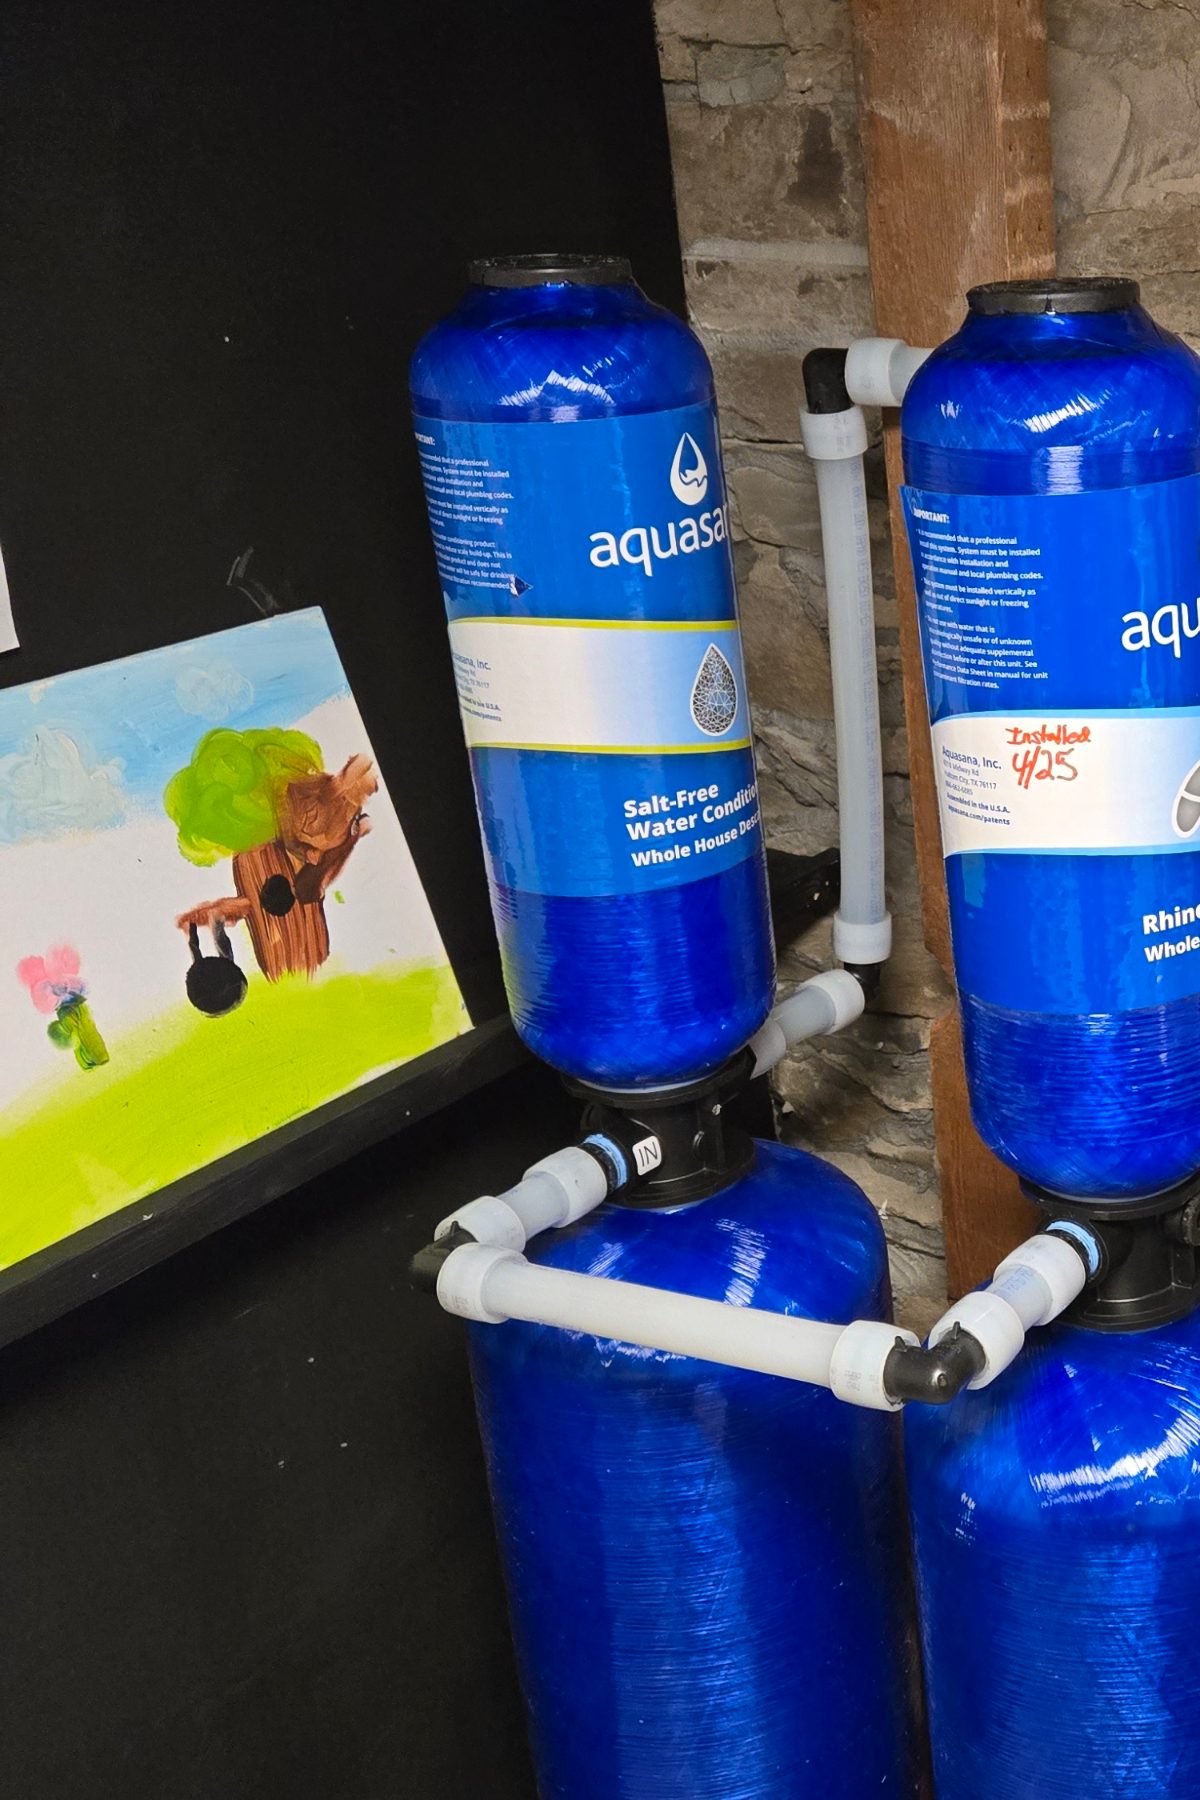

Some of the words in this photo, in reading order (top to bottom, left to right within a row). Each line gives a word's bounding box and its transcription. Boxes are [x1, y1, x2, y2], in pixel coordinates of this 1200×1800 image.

[483, 470, 509, 478] installed
[466, 489, 493, 500] plumbing
[474, 505, 499, 514] vertically
[975, 537, 1017, 545] professional
[960, 559, 993, 567] installation
[970, 570, 985, 578] local
[986, 571, 1019, 581] plumbing
[967, 586, 993, 595] installed
[994, 588, 1025, 597] vertically
[966, 598, 990, 607] sunlight
[959, 623, 974, 631] water
[975, 625, 988, 633] that
[963, 635, 982, 643] unsafe
[991, 636, 998, 644] of
[987, 649, 1034, 657] supplemental
[477, 659, 491, 670] Inc.
[970, 667, 986, 677] Sheet
[995, 671, 1020, 679] manual
[1021, 671, 1032, 679] for
[982, 681, 999, 689] rates.
[1005, 724, 1091, 745] Installed
[943, 745, 980, 767] Aquasana,
[983, 757, 1002, 770] Inc.
[1012, 746, 1078, 790] 4/25
[979, 780, 996, 790] 76117
[623, 784, 719, 818] Salt-Free
[979, 801, 988, 810] the
[990, 804, 1010, 813] U.S.A.
[626, 813, 697, 841] Water
[631, 844, 691, 867] Whole
[694, 828, 738, 854] House
[1144, 935, 1200, 962] Whole
[638, 1142, 658, 1167] IN
